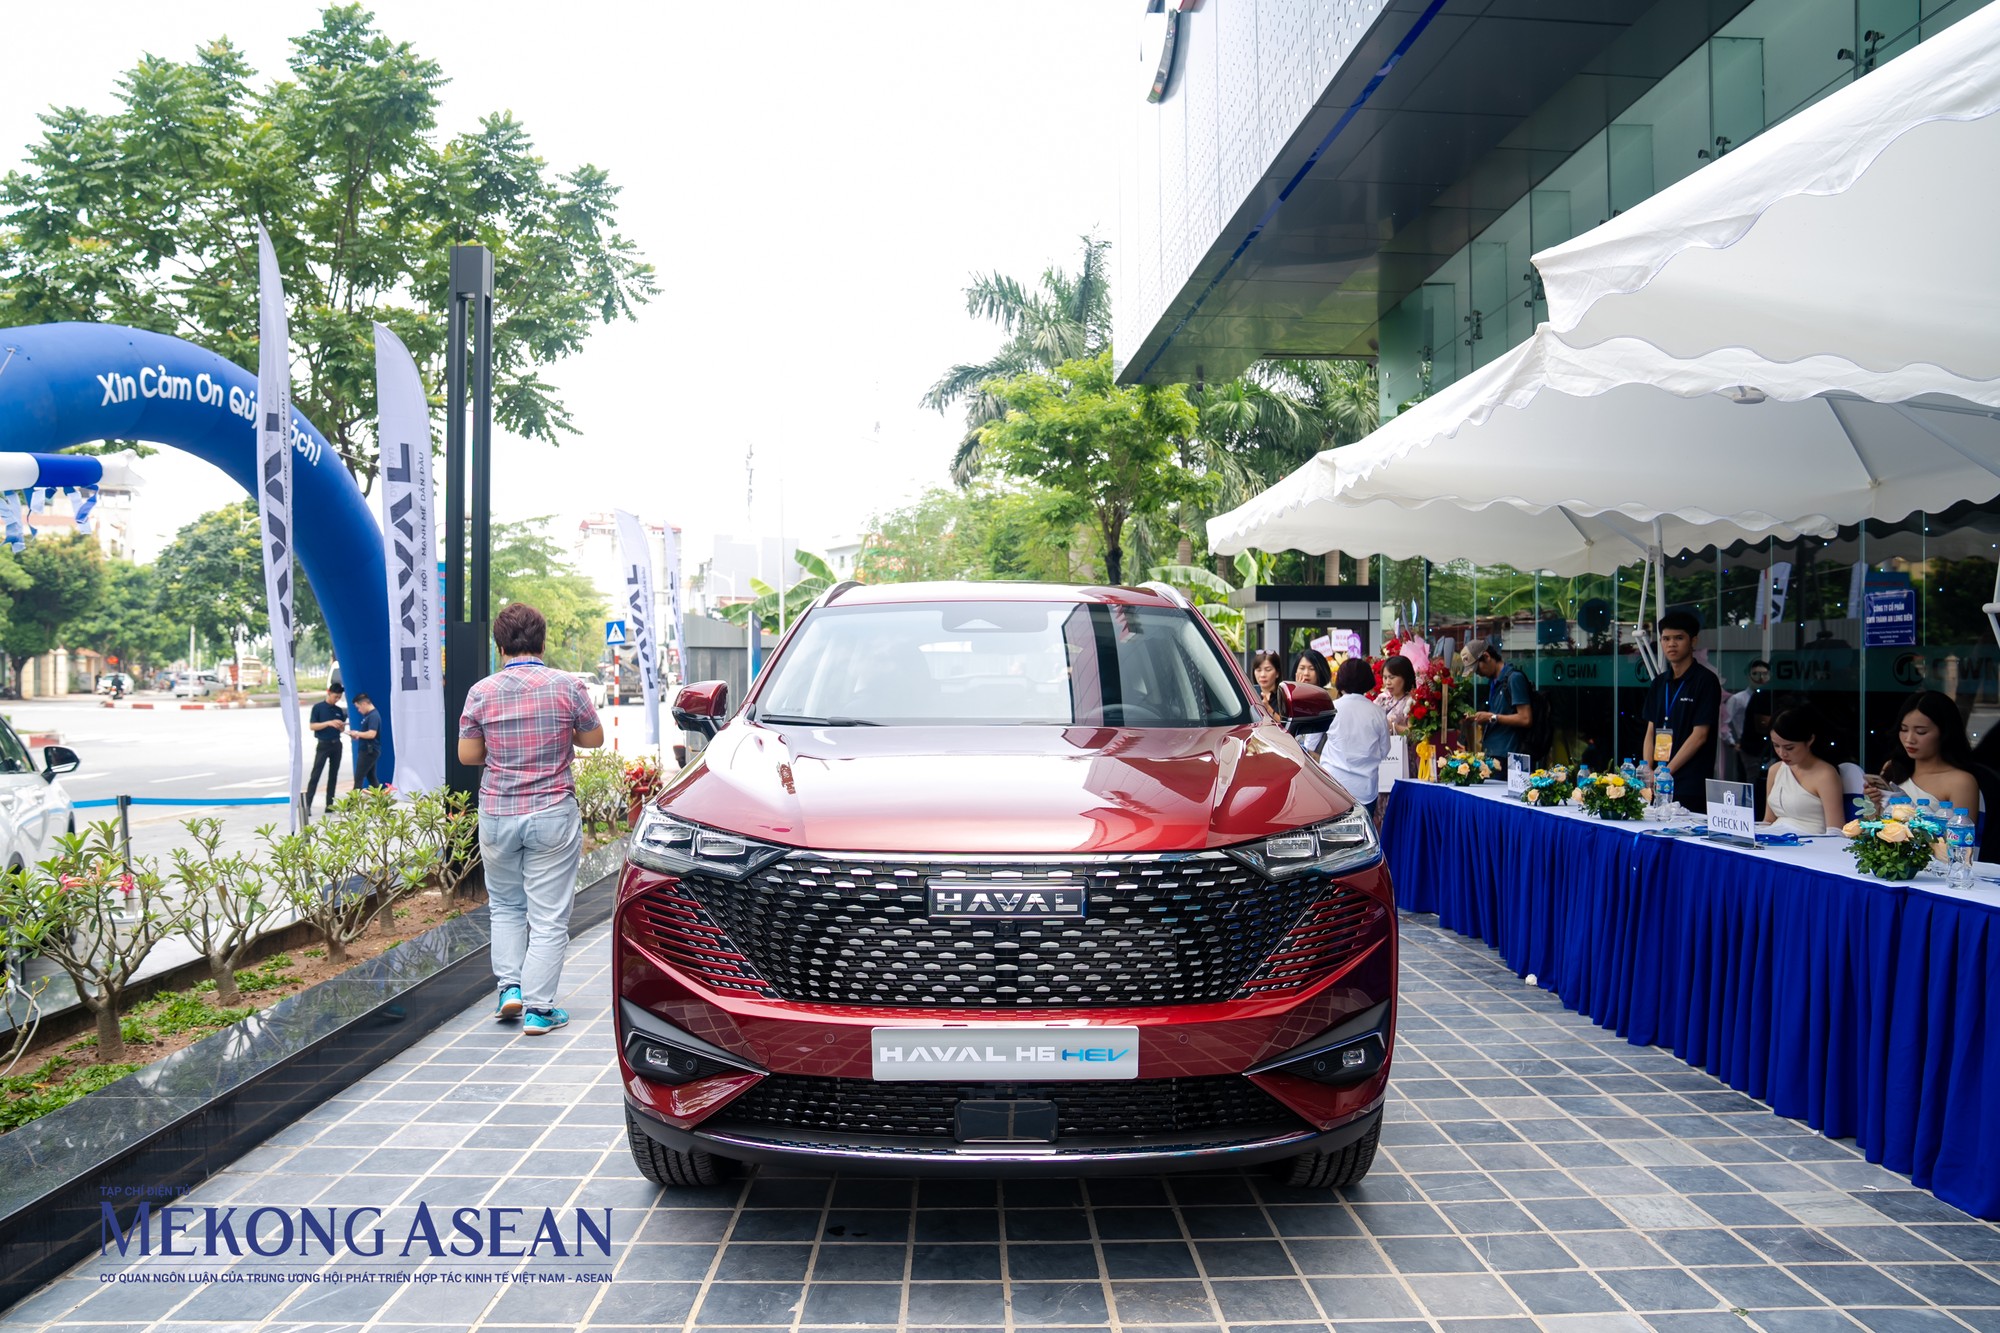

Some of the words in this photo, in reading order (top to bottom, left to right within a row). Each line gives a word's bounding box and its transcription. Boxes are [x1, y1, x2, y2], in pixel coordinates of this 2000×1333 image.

[96, 372, 137, 406] Xin
[139, 364, 192, 400] Cảm
[195, 372, 224, 408] Ơn
[386, 442, 419, 691] HAVAL
[421, 633, 429, 662] TOÀN
[423, 664, 430, 681] AN
[1567, 664, 1597, 679] GWM
[1776, 660, 1831, 681] GWM
[1712, 816, 1738, 830] CHECK
[1740, 820, 1750, 833] IN
[936, 892, 1078, 912] HAVAL
[879, 1046, 1007, 1062] HAVAL
[1015, 1046, 1056, 1062] H6
[1061, 1048, 1130, 1062] HEV
